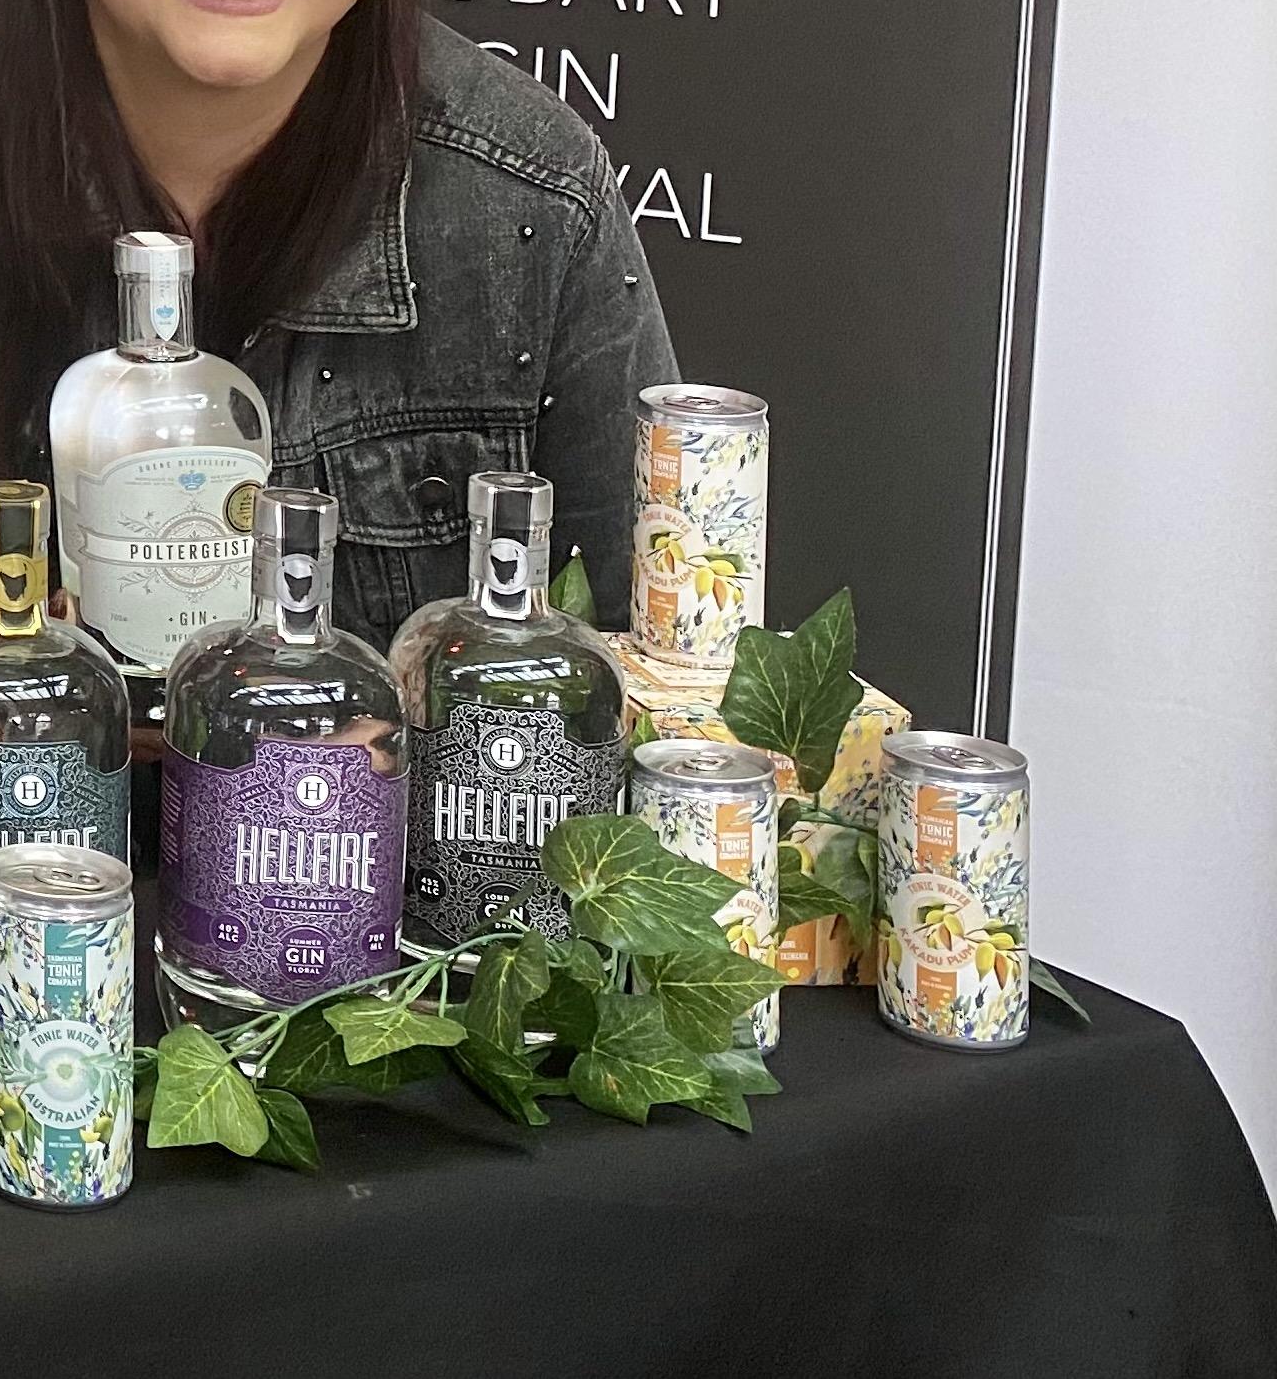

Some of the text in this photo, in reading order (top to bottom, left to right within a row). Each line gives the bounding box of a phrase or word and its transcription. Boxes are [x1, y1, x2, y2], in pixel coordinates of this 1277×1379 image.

[130, 539, 249, 560] POLTERGEIST
[670, 567, 695, 587] PLUM
[179, 611, 207, 626] GIN
[497, 744, 516, 762] H
[22, 781, 39, 799] H
[304, 782, 322, 800] H
[920, 823, 953, 839] TONIC
[236, 823, 378, 893] HELLFIRE
[471, 854, 538, 869] TASMANIA
[420, 885, 440, 896] ALC
[907, 881, 972, 907] TONIC WATER
[274, 898, 341, 911] TASMANIA
[218, 933, 239, 943] ALC
[368, 934, 385, 942] 700
[899, 928, 976, 966] KAKADU PLUM
[285, 948, 325, 965] GIN
[47, 964, 82, 976] TONIC
[47, 977, 82, 987] COMPANY
[32, 1029, 100, 1050] TONIC WATER
[25, 1091, 101, 1122] AUSTRALIAN
